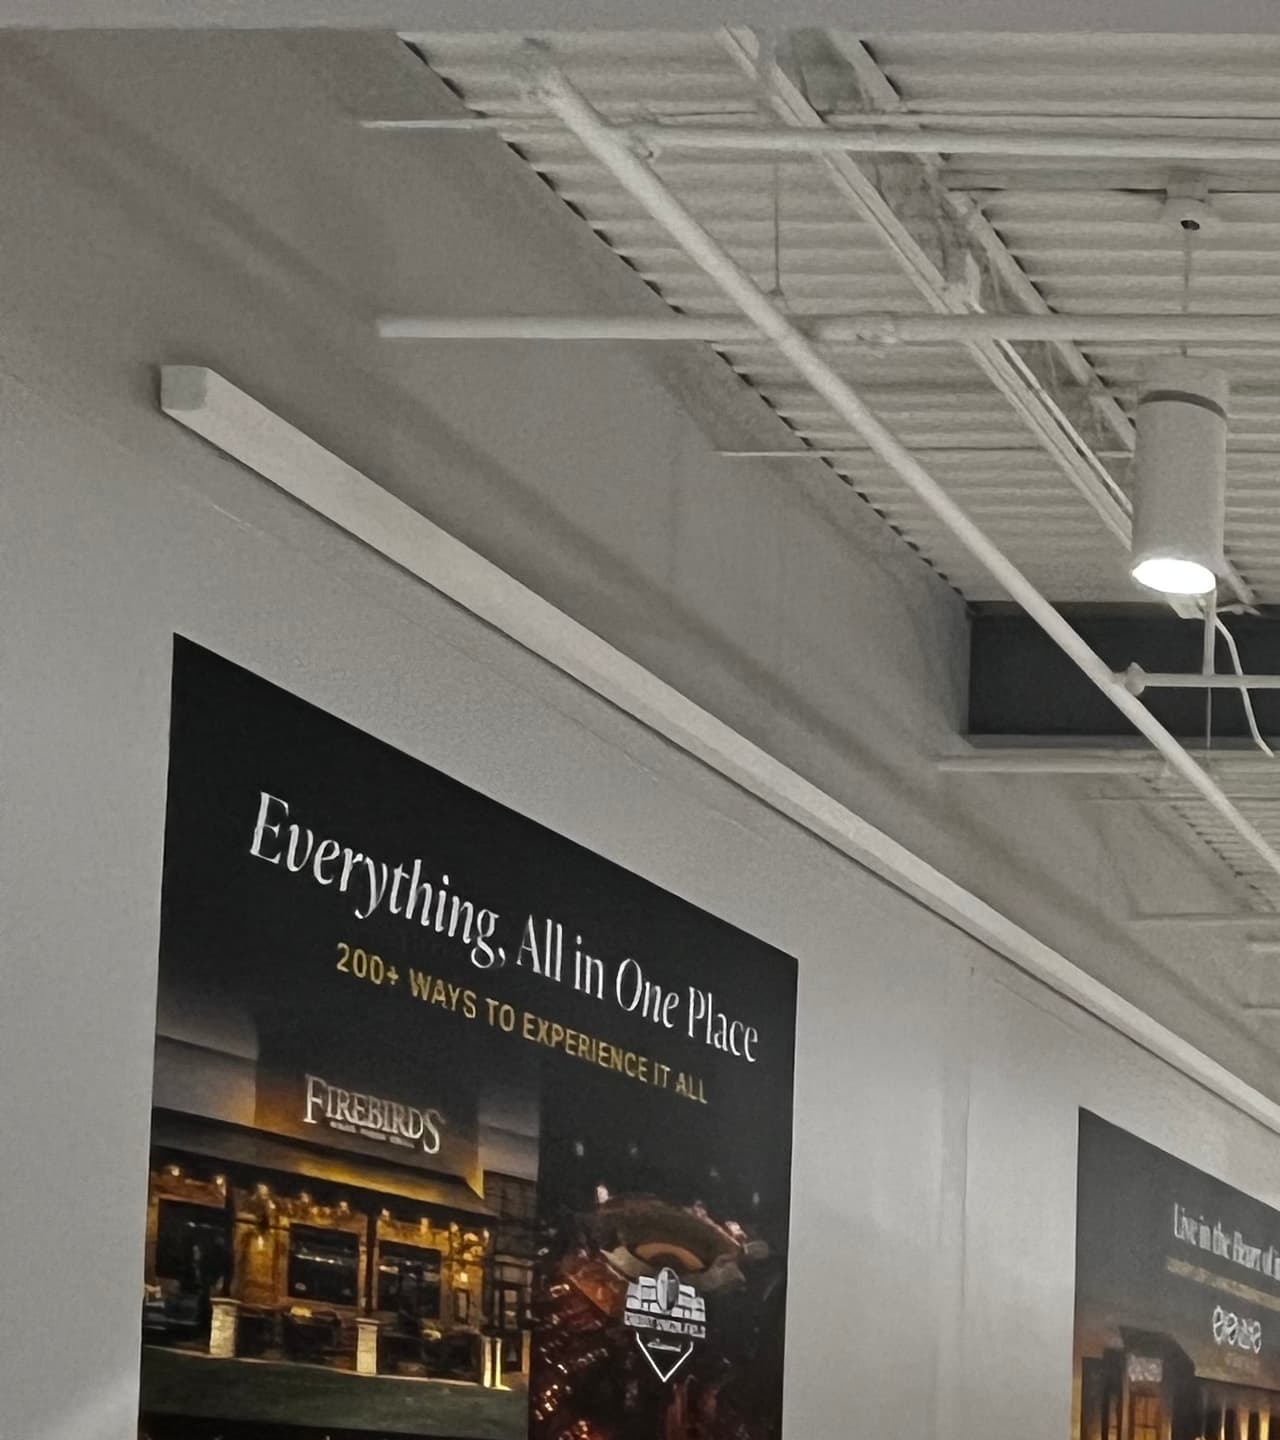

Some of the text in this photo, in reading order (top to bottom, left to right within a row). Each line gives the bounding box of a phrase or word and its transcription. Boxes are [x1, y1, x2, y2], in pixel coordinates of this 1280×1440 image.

[250, 791, 760, 1063] Everything, All in One Place
[336, 942, 708, 1104] 200+ WAYS TO EXPERIENCE IT ALL
